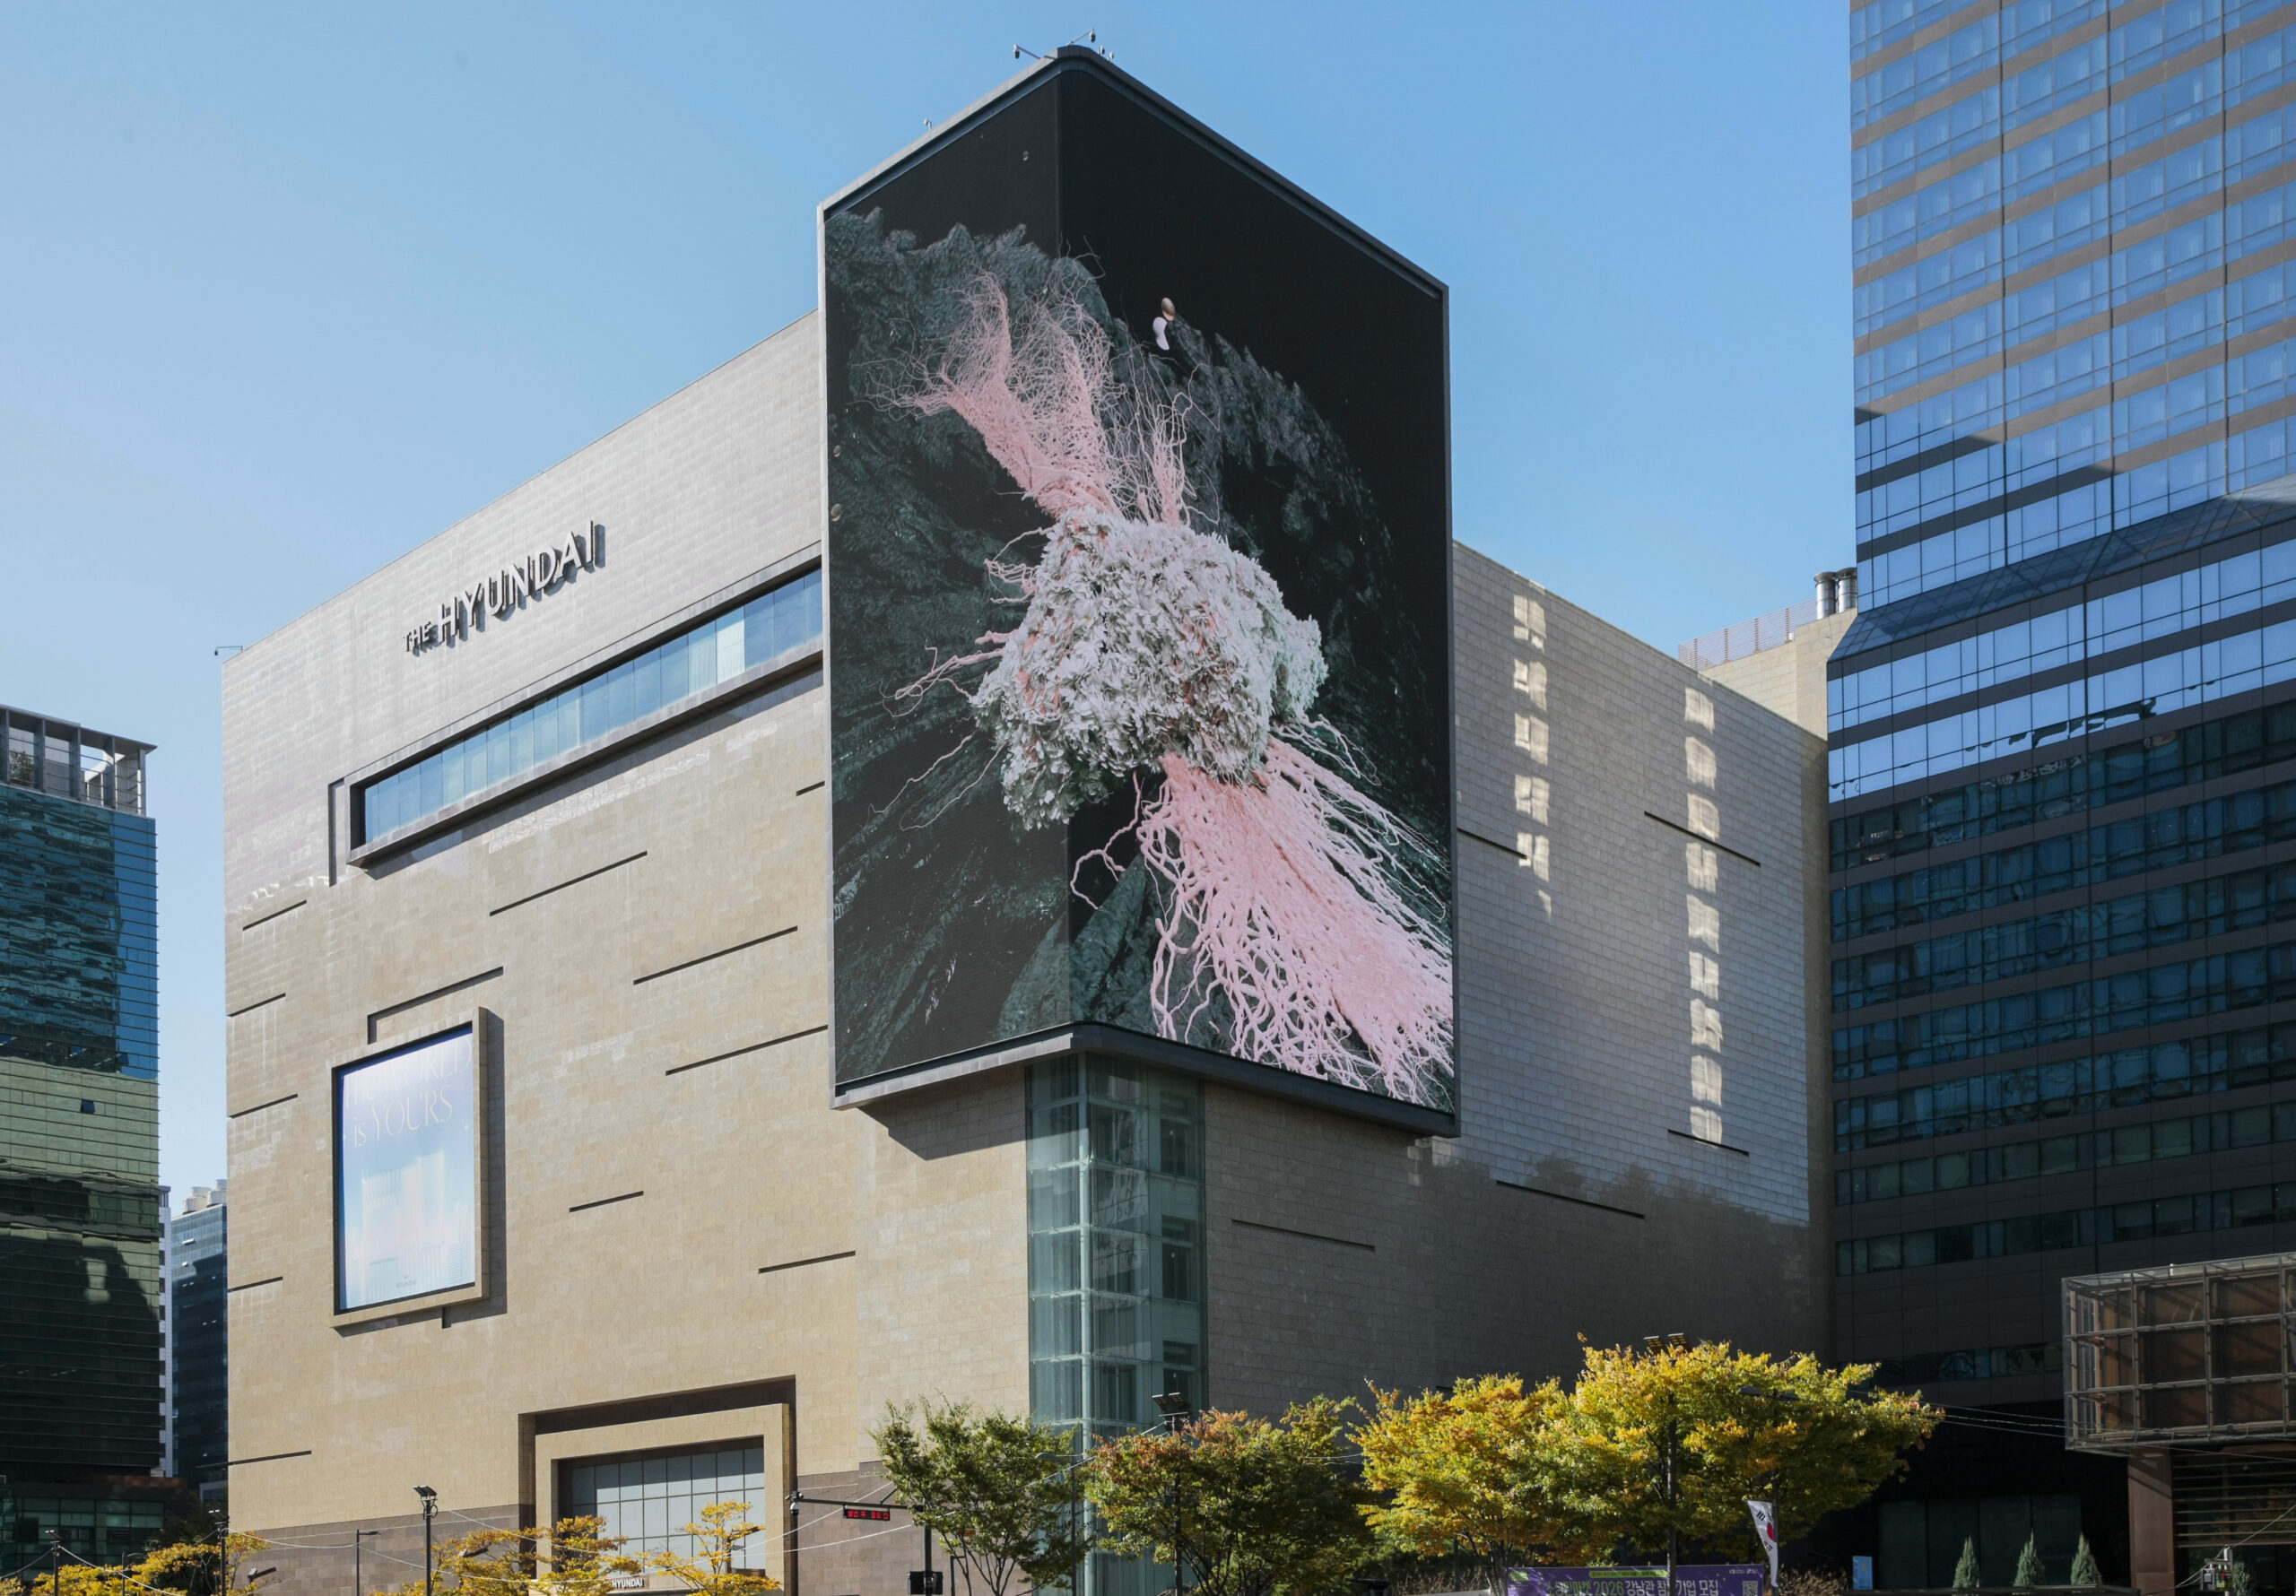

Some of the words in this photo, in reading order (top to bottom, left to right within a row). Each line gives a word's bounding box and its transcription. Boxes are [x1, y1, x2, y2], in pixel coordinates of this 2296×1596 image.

[404, 621, 432, 652] THE
[438, 520, 595, 643] HYUNDAI
[353, 1116, 367, 1149] is
[370, 1084, 454, 1141] YOURS
[612, 1578, 644, 1588] HYUNDAI
[1593, 1580, 1624, 1596] 2026
[1625, 1580, 1655, 1596] 강남관
[1699, 1580, 1719, 1596] 모집
